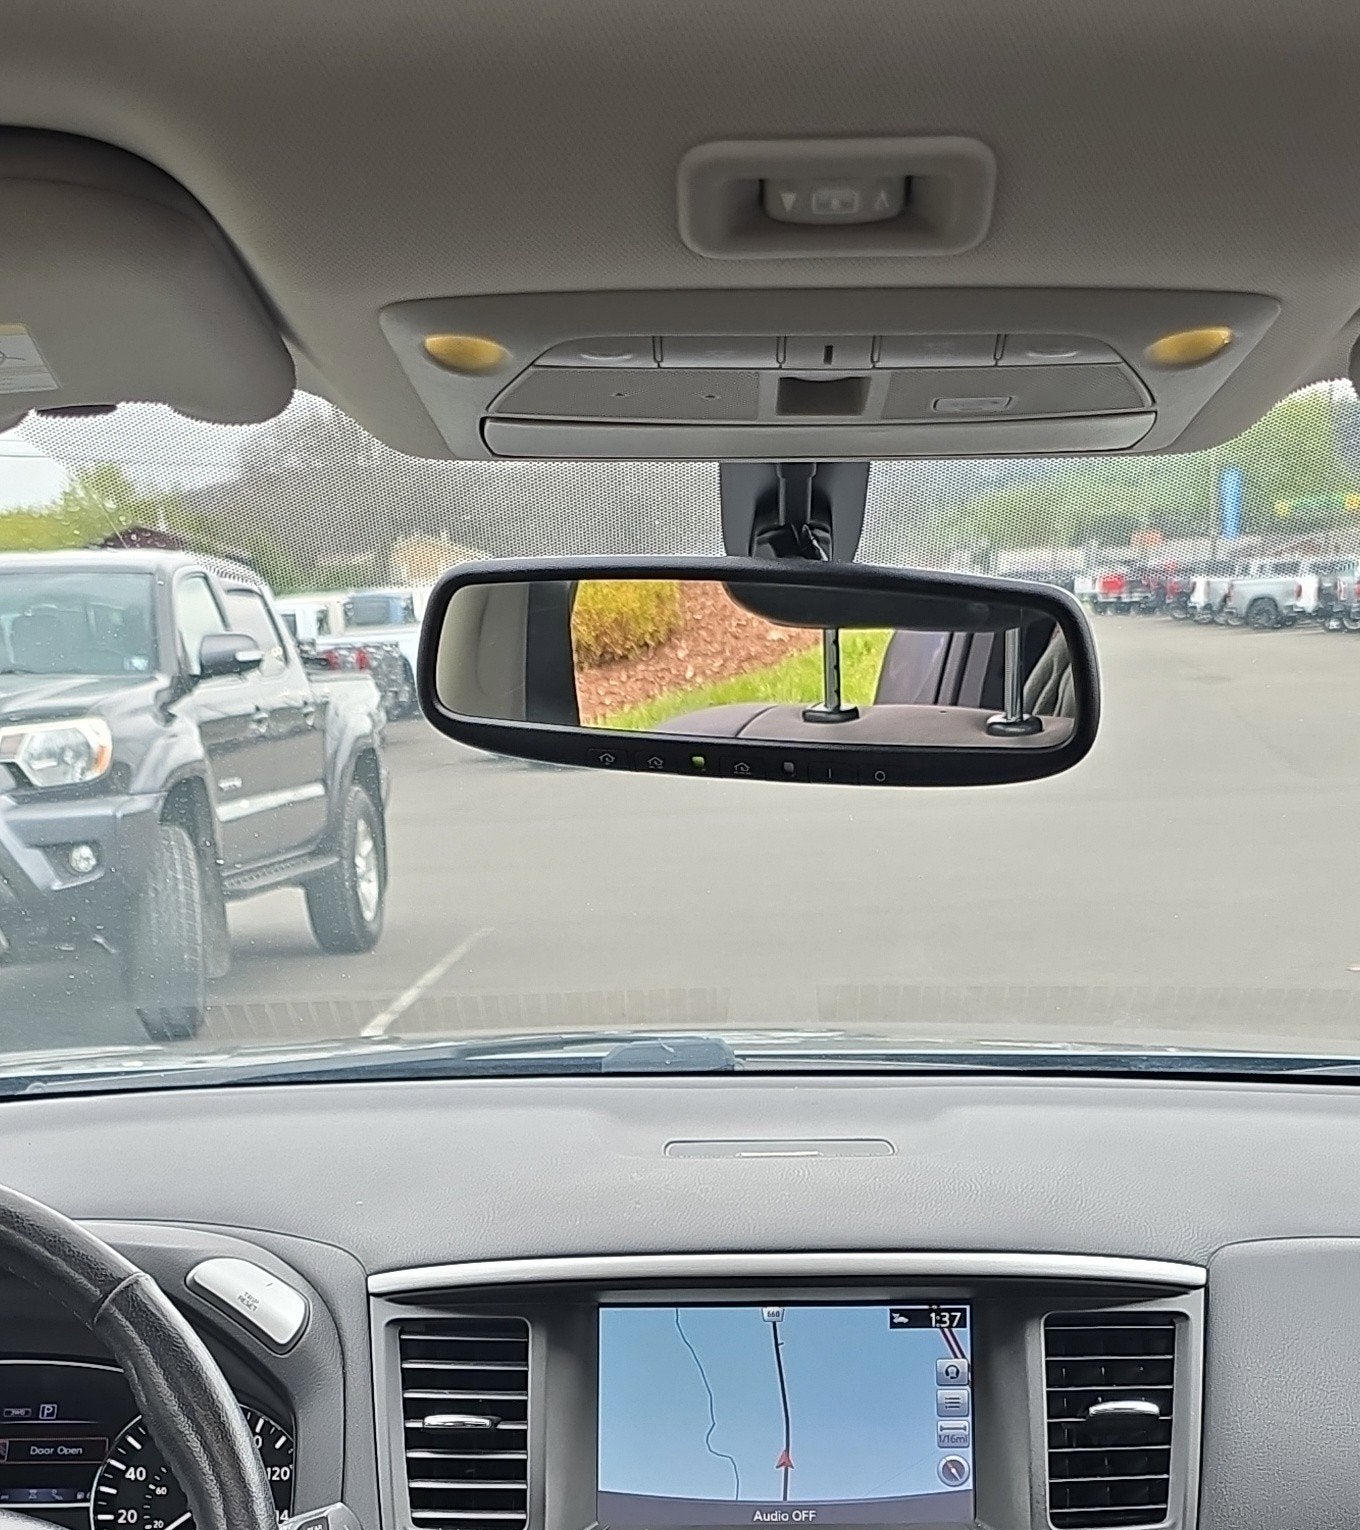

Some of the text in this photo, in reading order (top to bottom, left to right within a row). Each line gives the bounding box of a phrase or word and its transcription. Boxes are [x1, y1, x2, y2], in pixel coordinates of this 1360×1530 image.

[929, 1312, 962, 1328] 1:37
[44, 1405, 53, 1417] P
[30, 1445, 83, 1457] Door Open
[125, 1467, 146, 1481] 40
[156, 1486, 167, 1495] 60
[118, 1509, 137, 1523] 20
[753, 1509, 817, 1522] Audio OFF
[153, 1520, 164, 1529] 20
